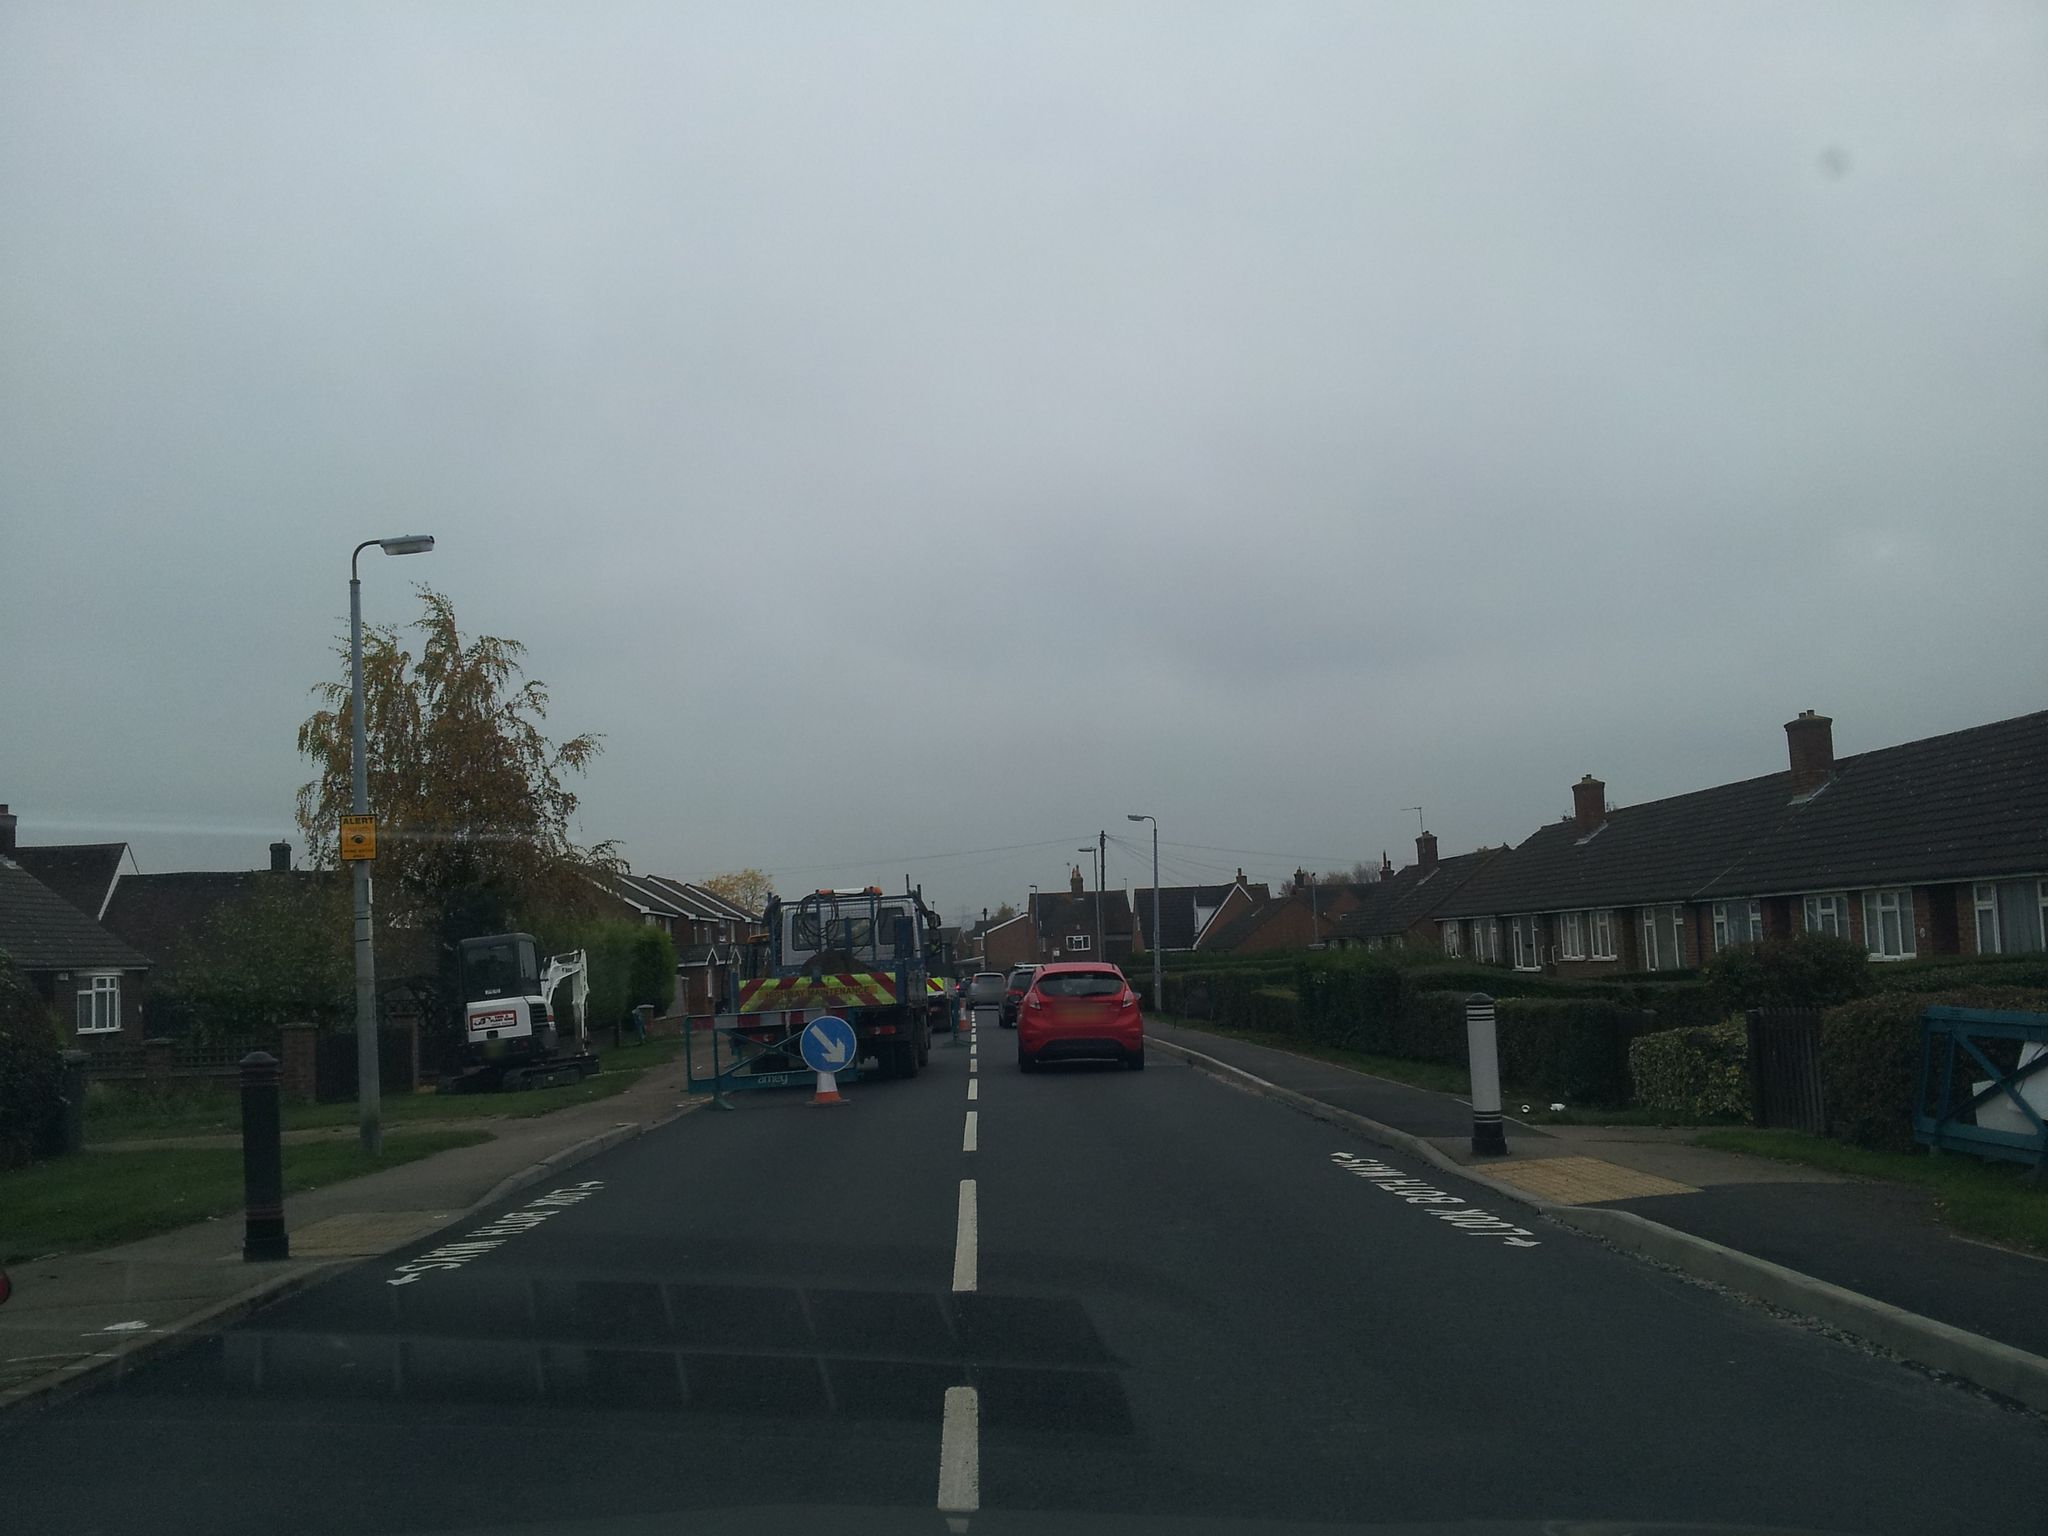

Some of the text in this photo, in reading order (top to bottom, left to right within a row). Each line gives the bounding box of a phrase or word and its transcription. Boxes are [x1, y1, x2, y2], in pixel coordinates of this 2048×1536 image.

[811, 986, 869, 997] MAINTENANCE
[758, 1074, 789, 1085] amey
[1331, 1158, 1535, 1237] LOOK BOTH WAYS
[394, 1186, 605, 1273] LOOK BOTH WAYS
